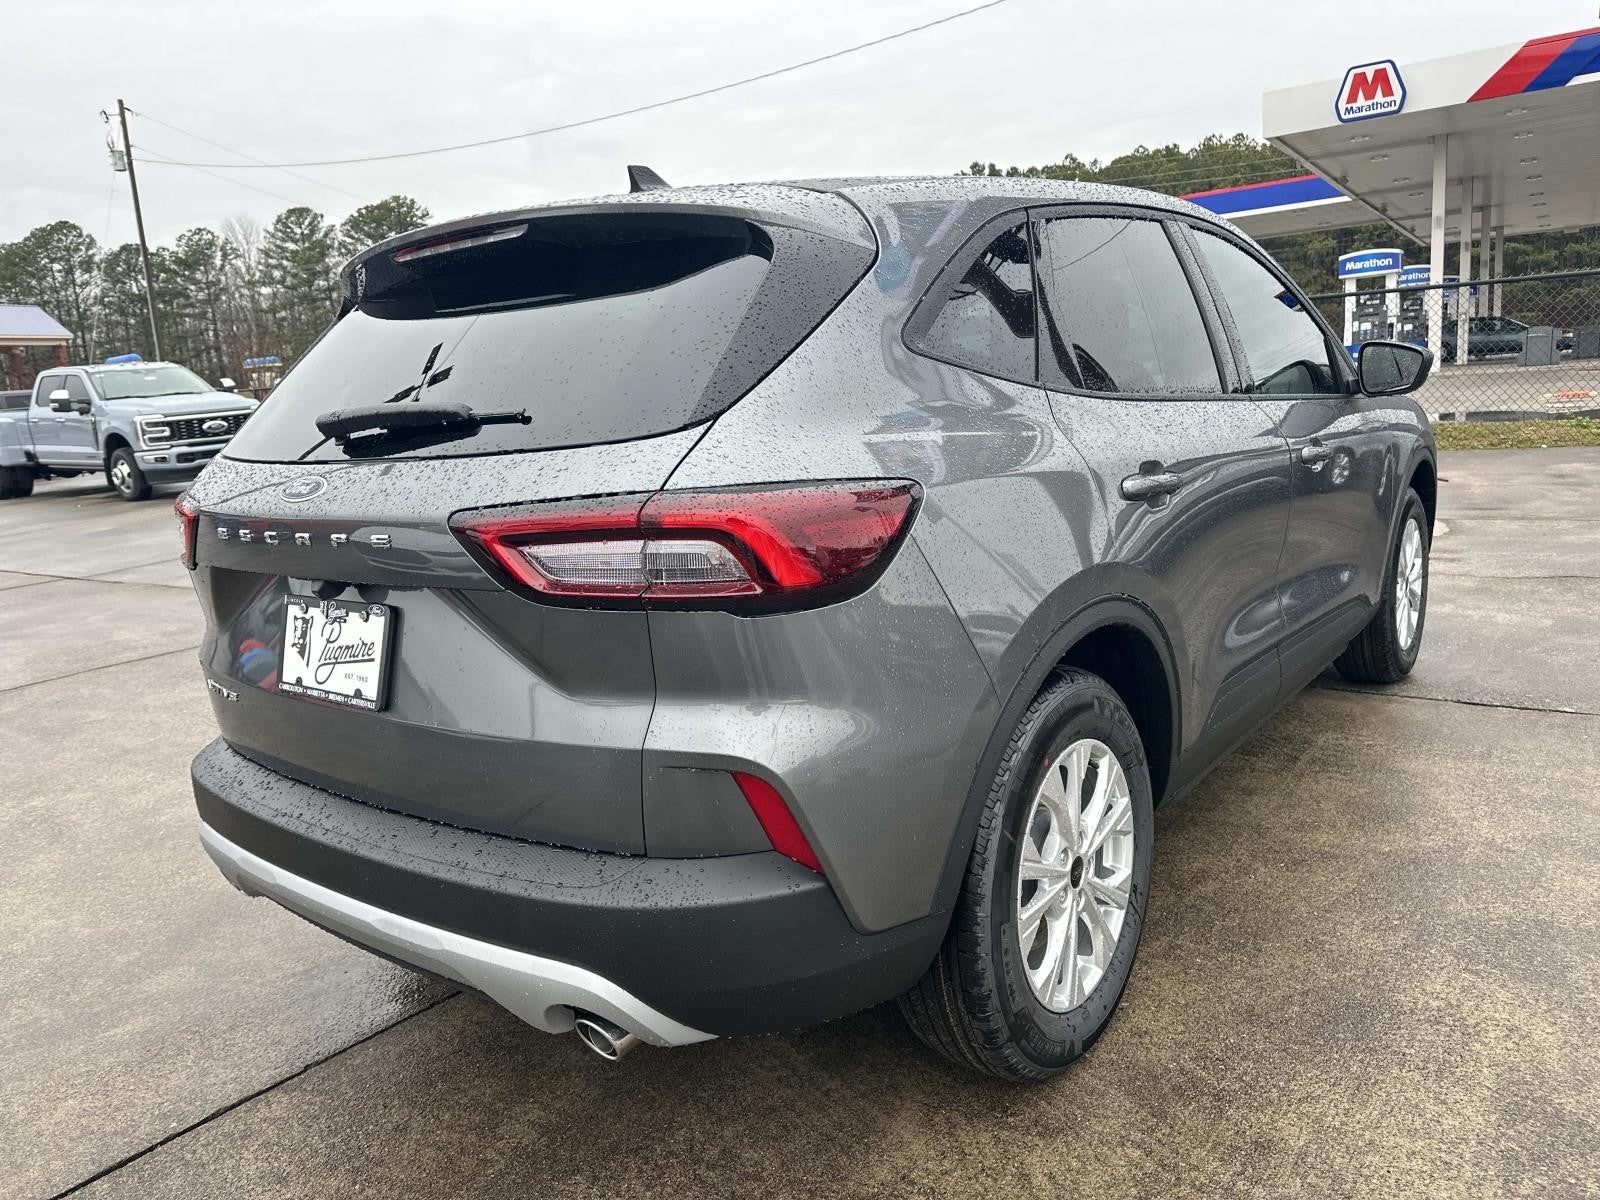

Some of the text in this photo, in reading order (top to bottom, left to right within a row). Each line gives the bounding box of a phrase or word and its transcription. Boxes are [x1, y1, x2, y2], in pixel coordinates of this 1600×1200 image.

[1346, 67, 1394, 105] M
[1344, 99, 1397, 116] Marathon
[1345, 257, 1393, 271] Marathon
[1397, 271, 1430, 282] arathon
[217, 527, 392, 549] ESCAPE
[315, 621, 375, 685] Pugmire
